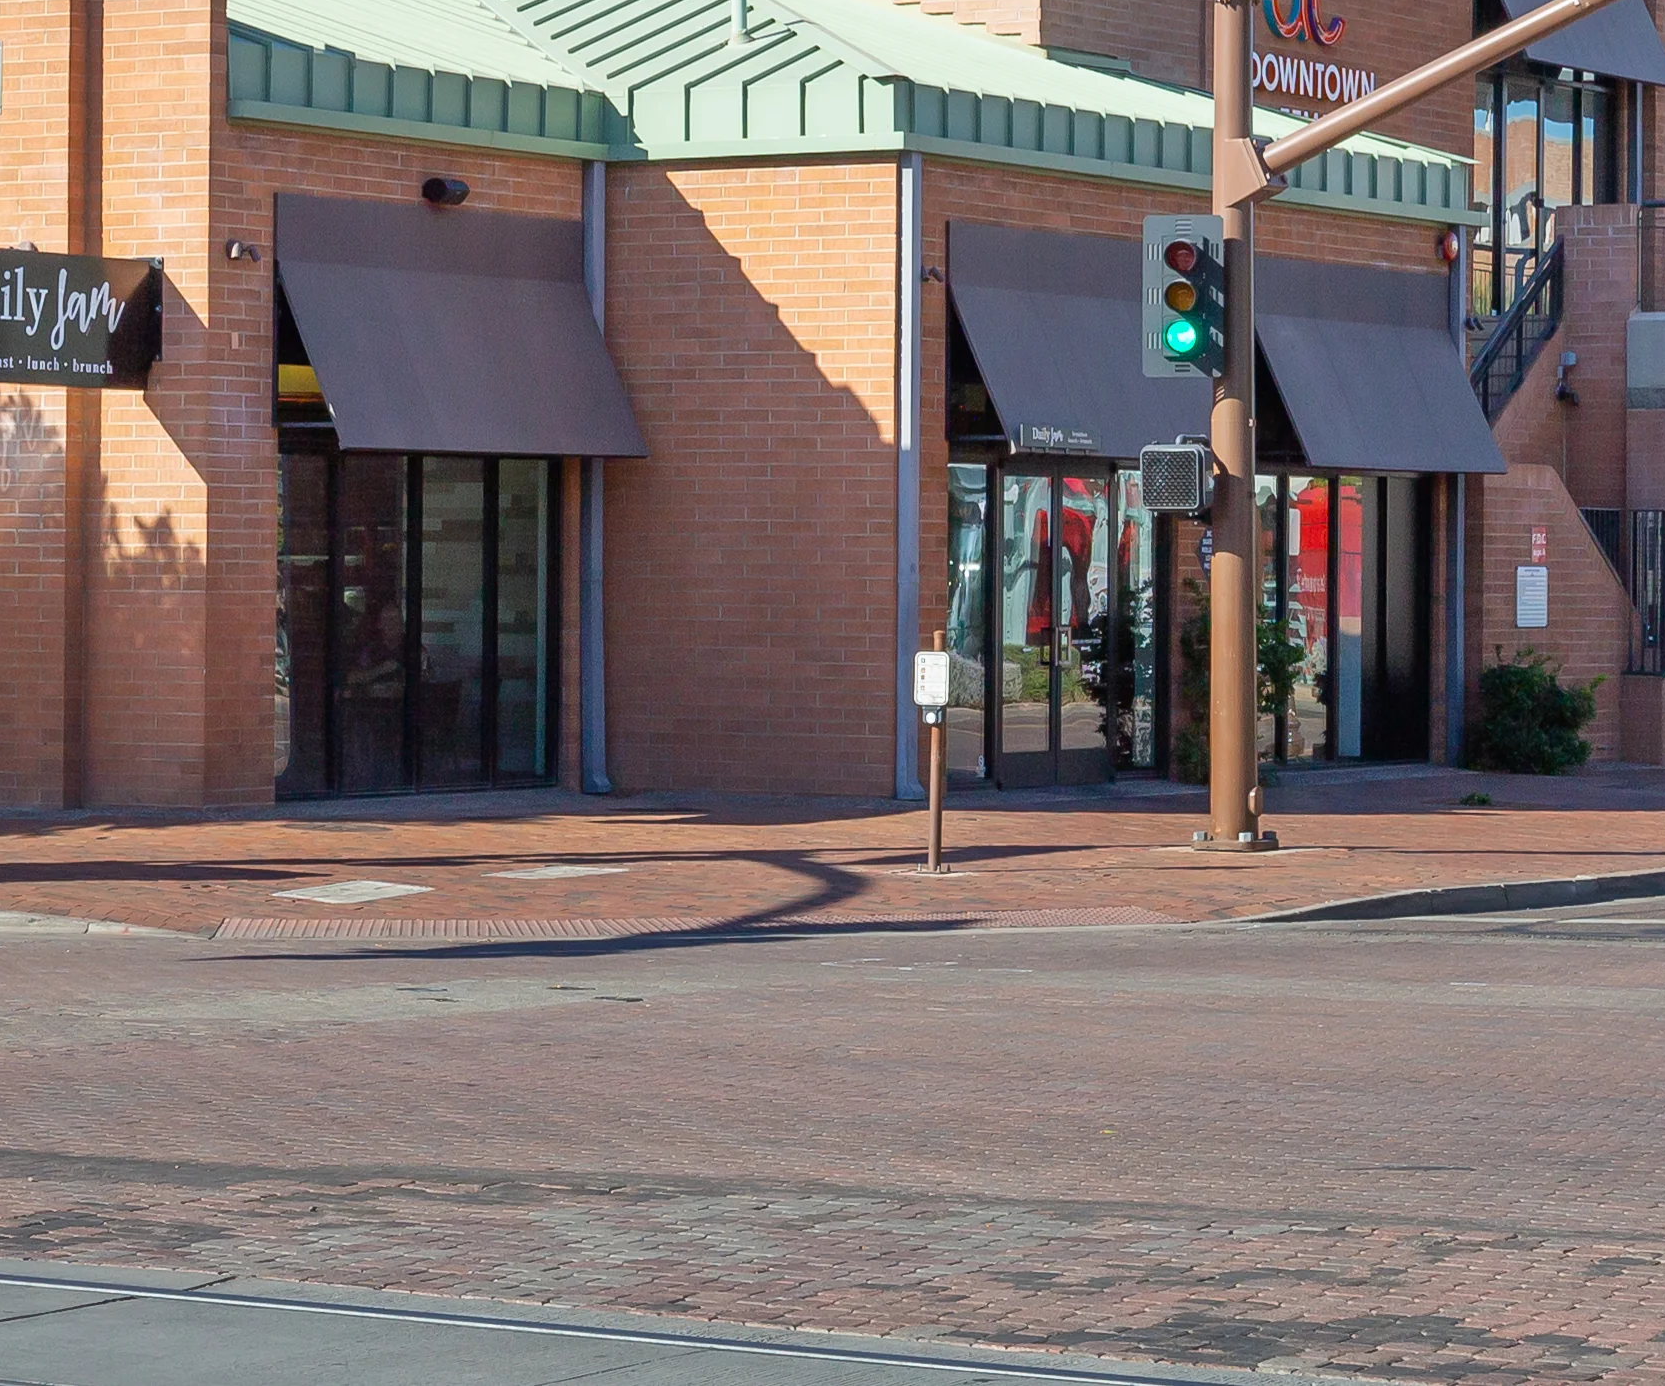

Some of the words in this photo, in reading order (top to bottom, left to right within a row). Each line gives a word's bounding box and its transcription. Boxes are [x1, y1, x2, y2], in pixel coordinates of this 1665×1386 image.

[50, 267, 126, 351] Jam
[26, 354, 60, 372] lunch
[72, 359, 114, 375] brunch
